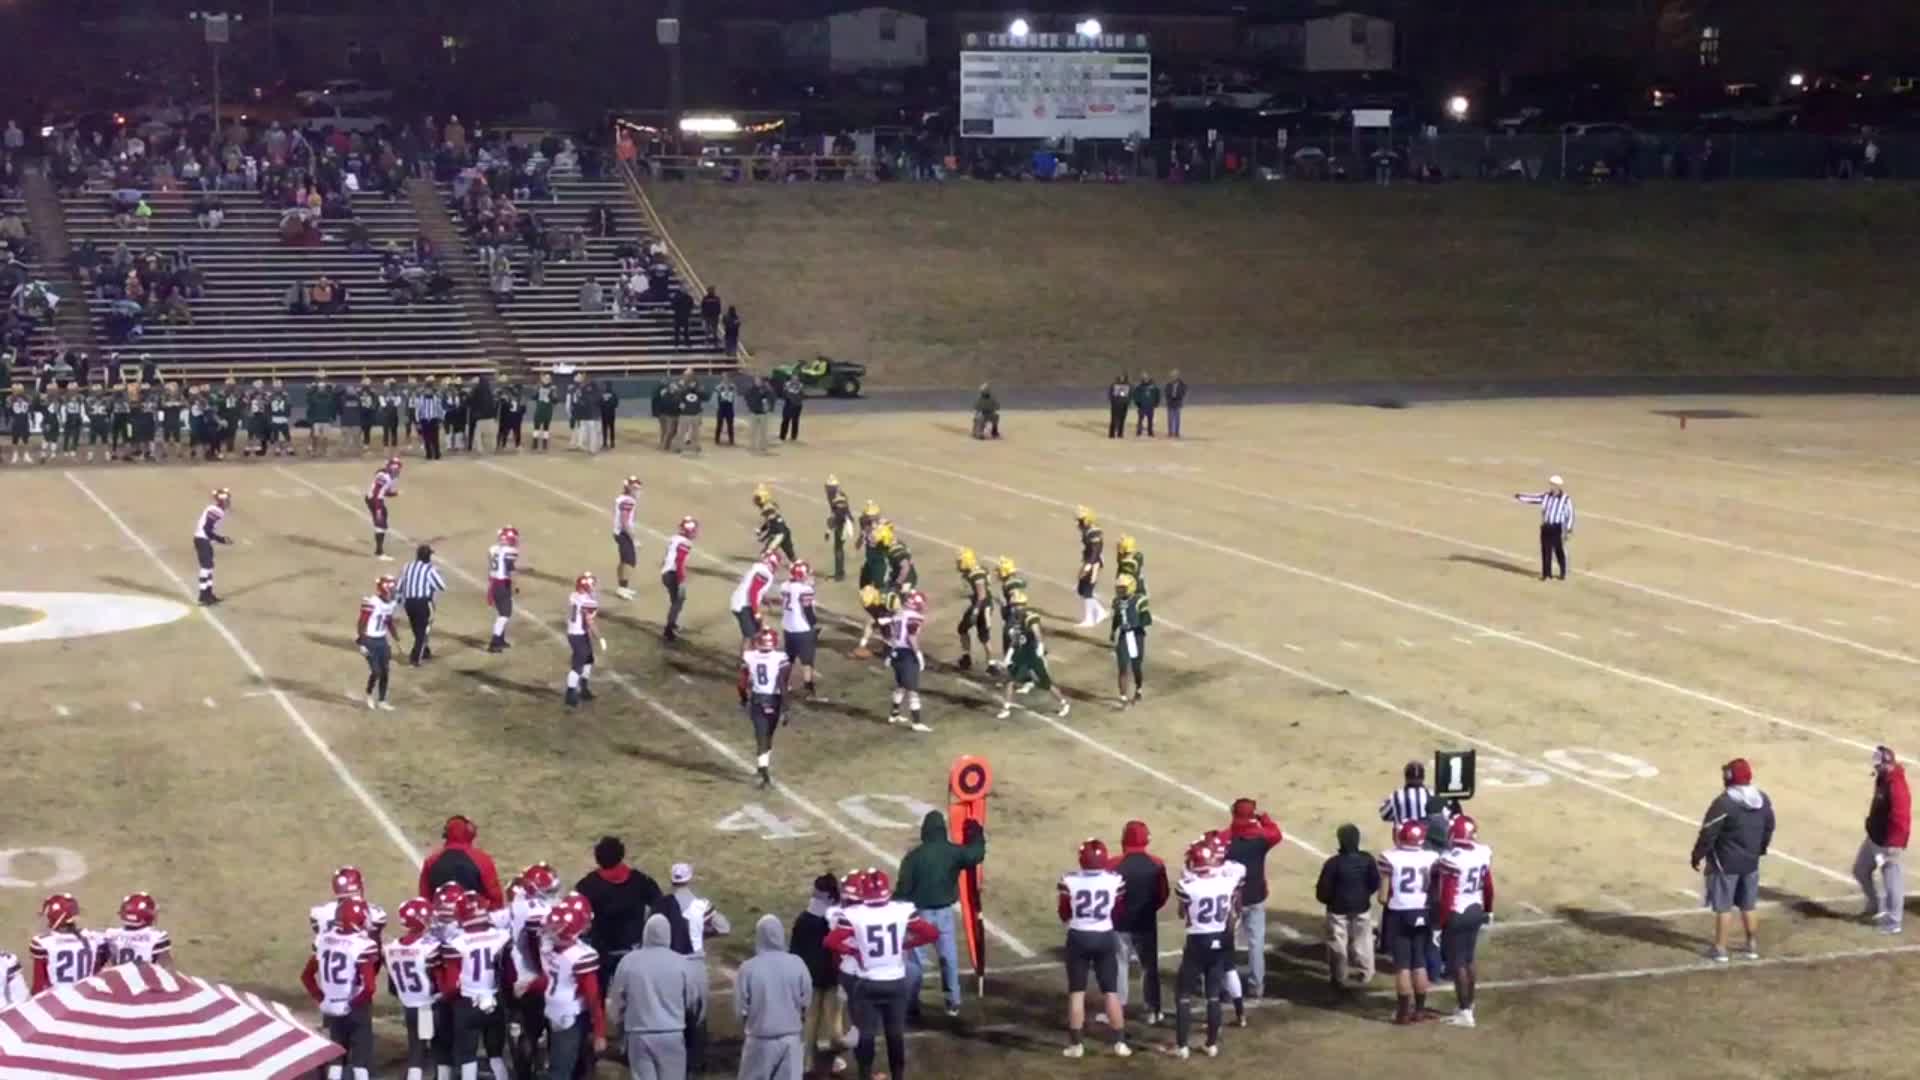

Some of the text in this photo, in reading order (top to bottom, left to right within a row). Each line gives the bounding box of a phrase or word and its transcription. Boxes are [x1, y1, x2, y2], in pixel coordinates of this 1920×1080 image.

[756, 663, 769, 685] 8
[1447, 756, 1464, 791] 1
[1075, 889, 1110, 921] 22
[866, 922, 899, 958] 51
[56, 949, 94, 983] 20
[322, 949, 348, 985] 12
[392, 960, 423, 993] 15
[470, 947, 496, 982] 14
